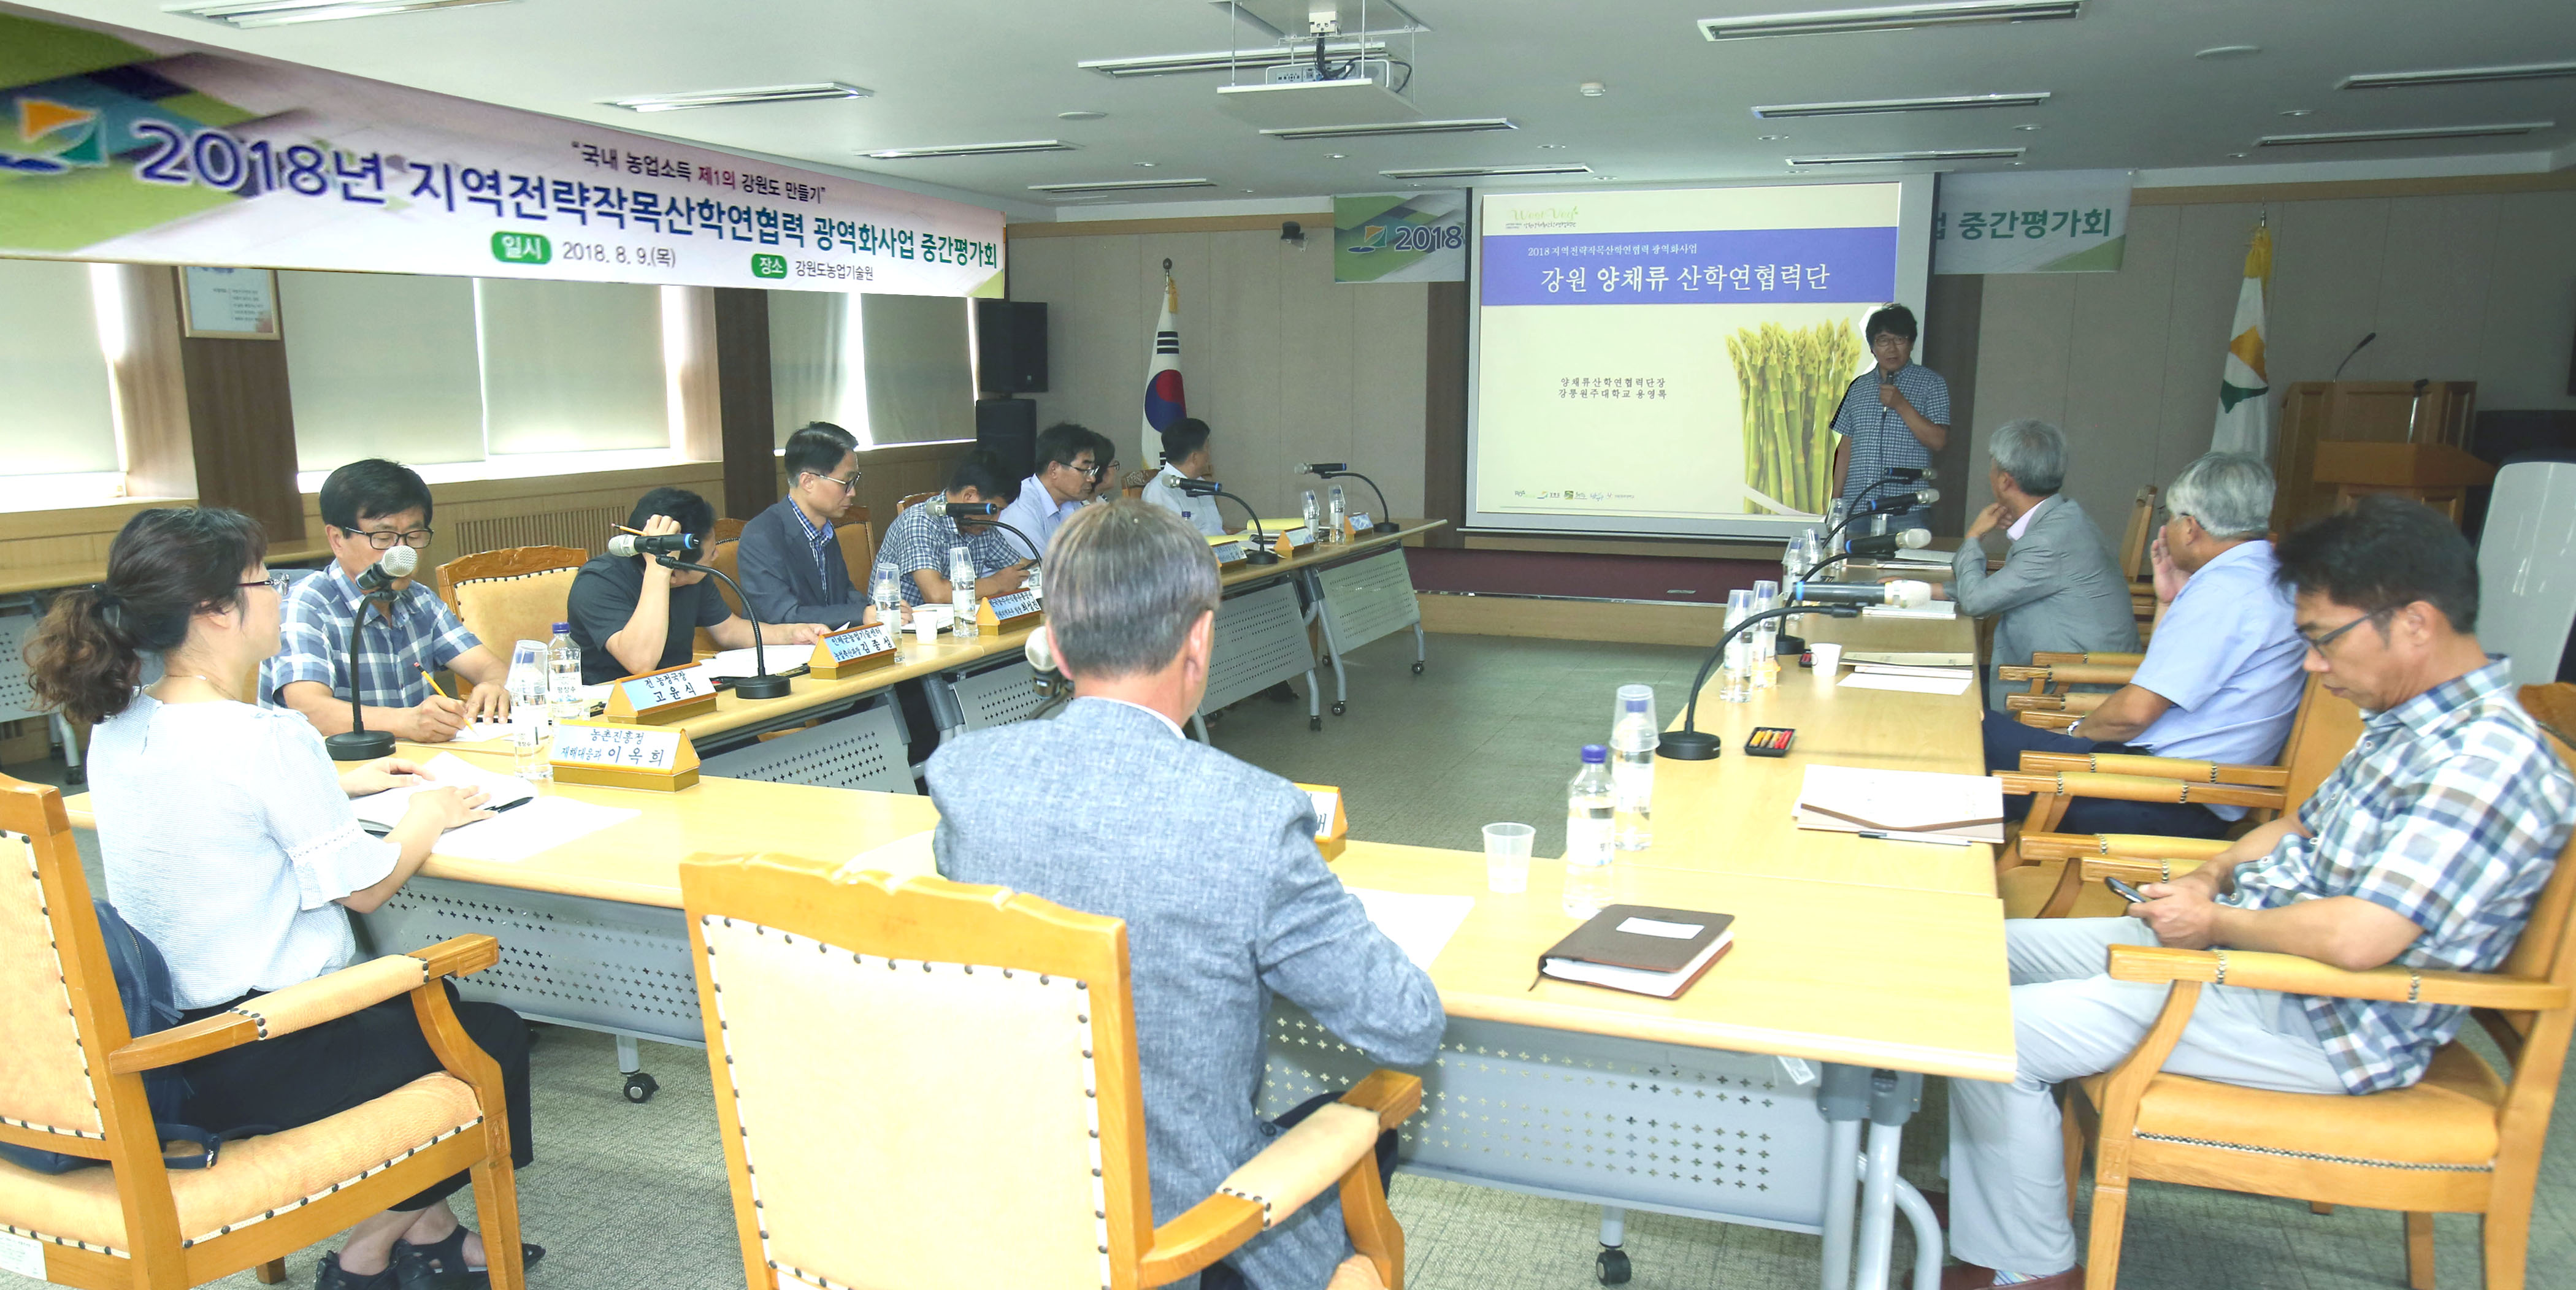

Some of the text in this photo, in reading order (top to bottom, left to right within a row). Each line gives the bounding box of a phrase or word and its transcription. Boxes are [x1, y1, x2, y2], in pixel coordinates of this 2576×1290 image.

[627, 152, 692, 182] 농업소득
[698, 166, 735, 190] 제1의
[742, 173, 781, 196] 강원도
[135, 124, 997, 269] 2018년 지역전략작목산학연협력 광역화사업 중간평가회
[1958, 208, 2111, 240] 중간평가회
[500, 234, 543, 261] 일시
[562, 242, 610, 264] 2018.
[636, 246, 675, 268] 9.(목)
[1395, 225, 1463, 251] 2018
[1528, 246, 1550, 256] 2018
[759, 256, 874, 281] 장소 강원도농업기술원
[1541, 264, 1831, 293] 강원 양채류 산학연협력단
[645, 671, 687, 689] 전 농정국장
[561, 746, 602, 761] 재해대응과
